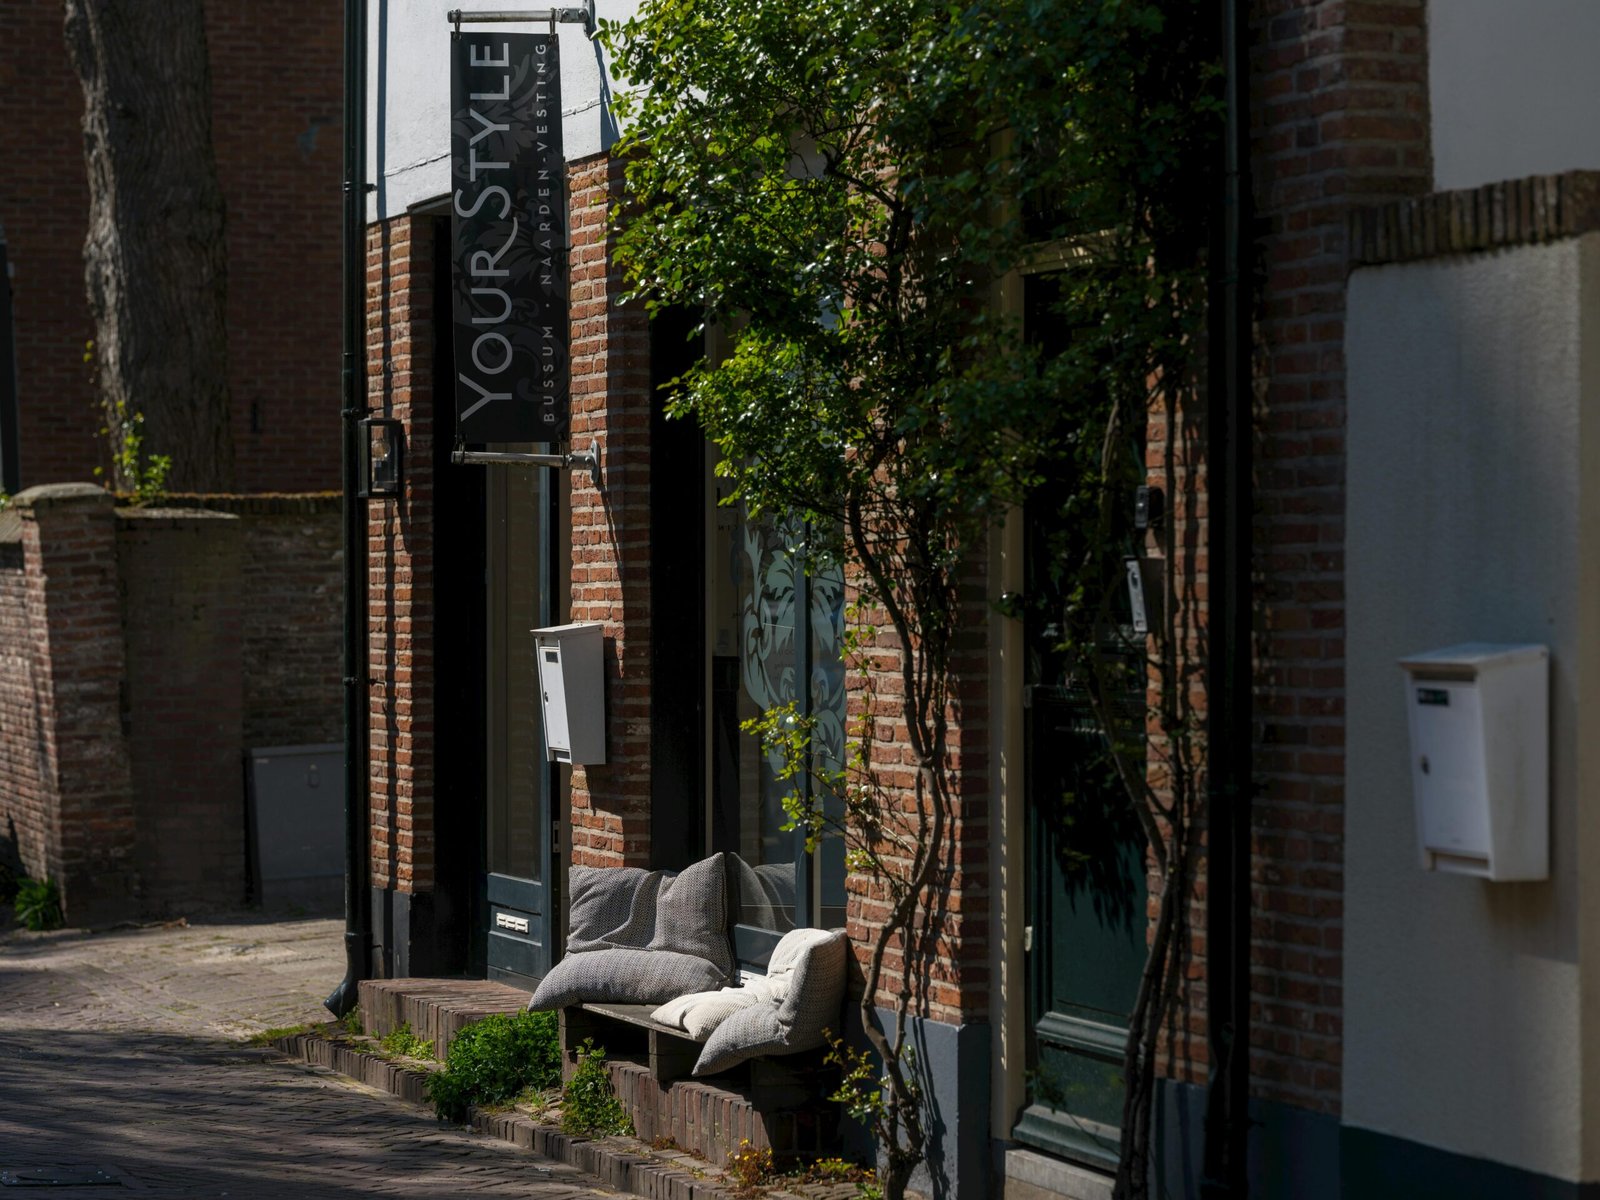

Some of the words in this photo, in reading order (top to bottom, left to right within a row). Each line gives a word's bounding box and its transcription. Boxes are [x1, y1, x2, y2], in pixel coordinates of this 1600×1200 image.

[454, 42, 511, 220] STYLE
[535, 44, 552, 285] NAARDEN-VESTING
[458, 216, 519, 422] YOUR
[541, 325, 555, 423] BUSSUM
